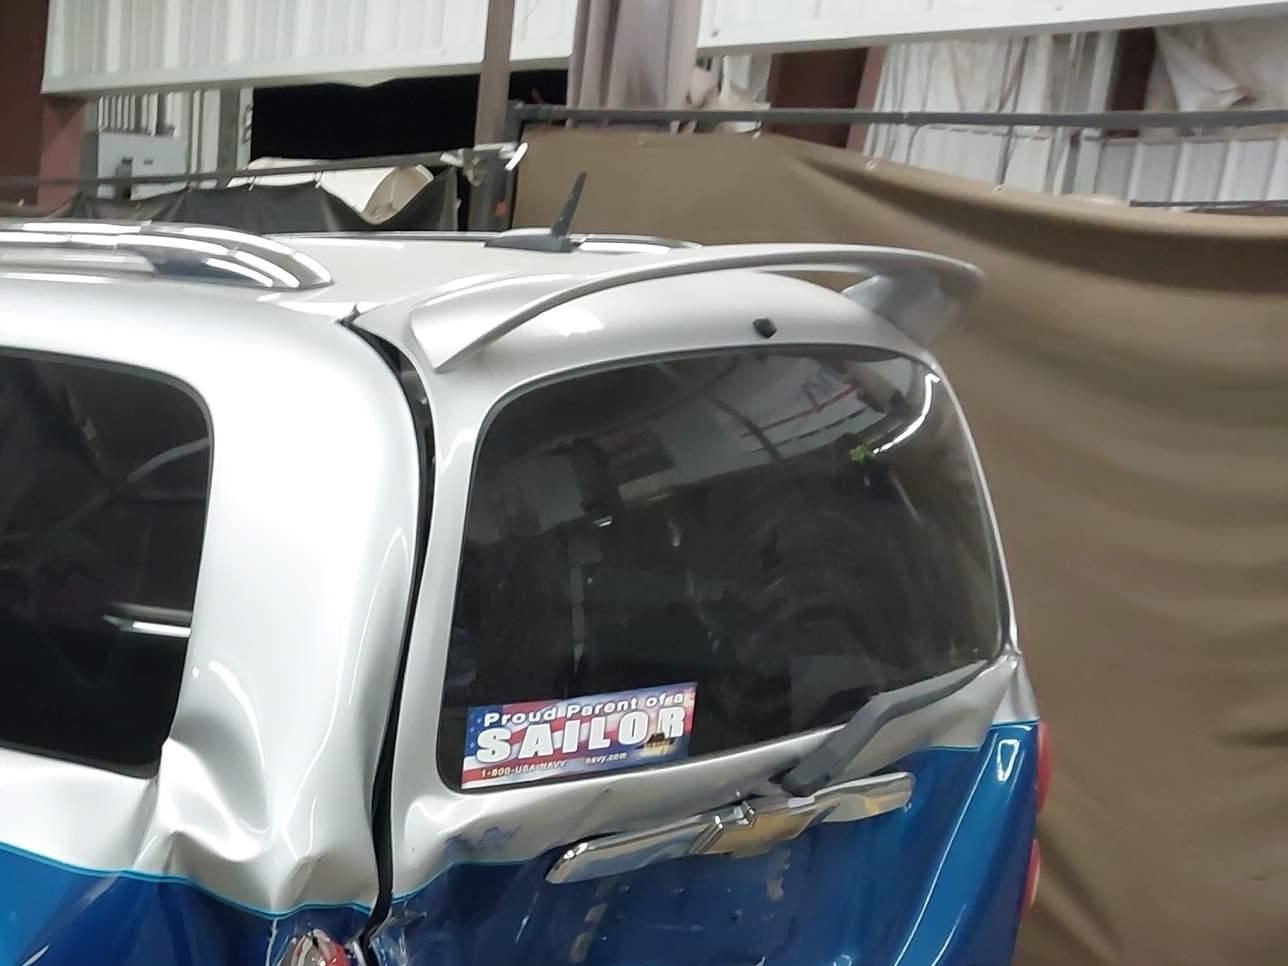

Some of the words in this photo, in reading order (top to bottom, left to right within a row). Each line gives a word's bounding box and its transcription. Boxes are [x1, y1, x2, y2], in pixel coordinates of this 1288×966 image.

[484, 706, 557, 727] Proud
[567, 697, 637, 718] Parent
[646, 693, 667, 707] of
[674, 692, 684, 704] a
[476, 706, 686, 764] SAILOR
[585, 752, 627, 766] navy.com
